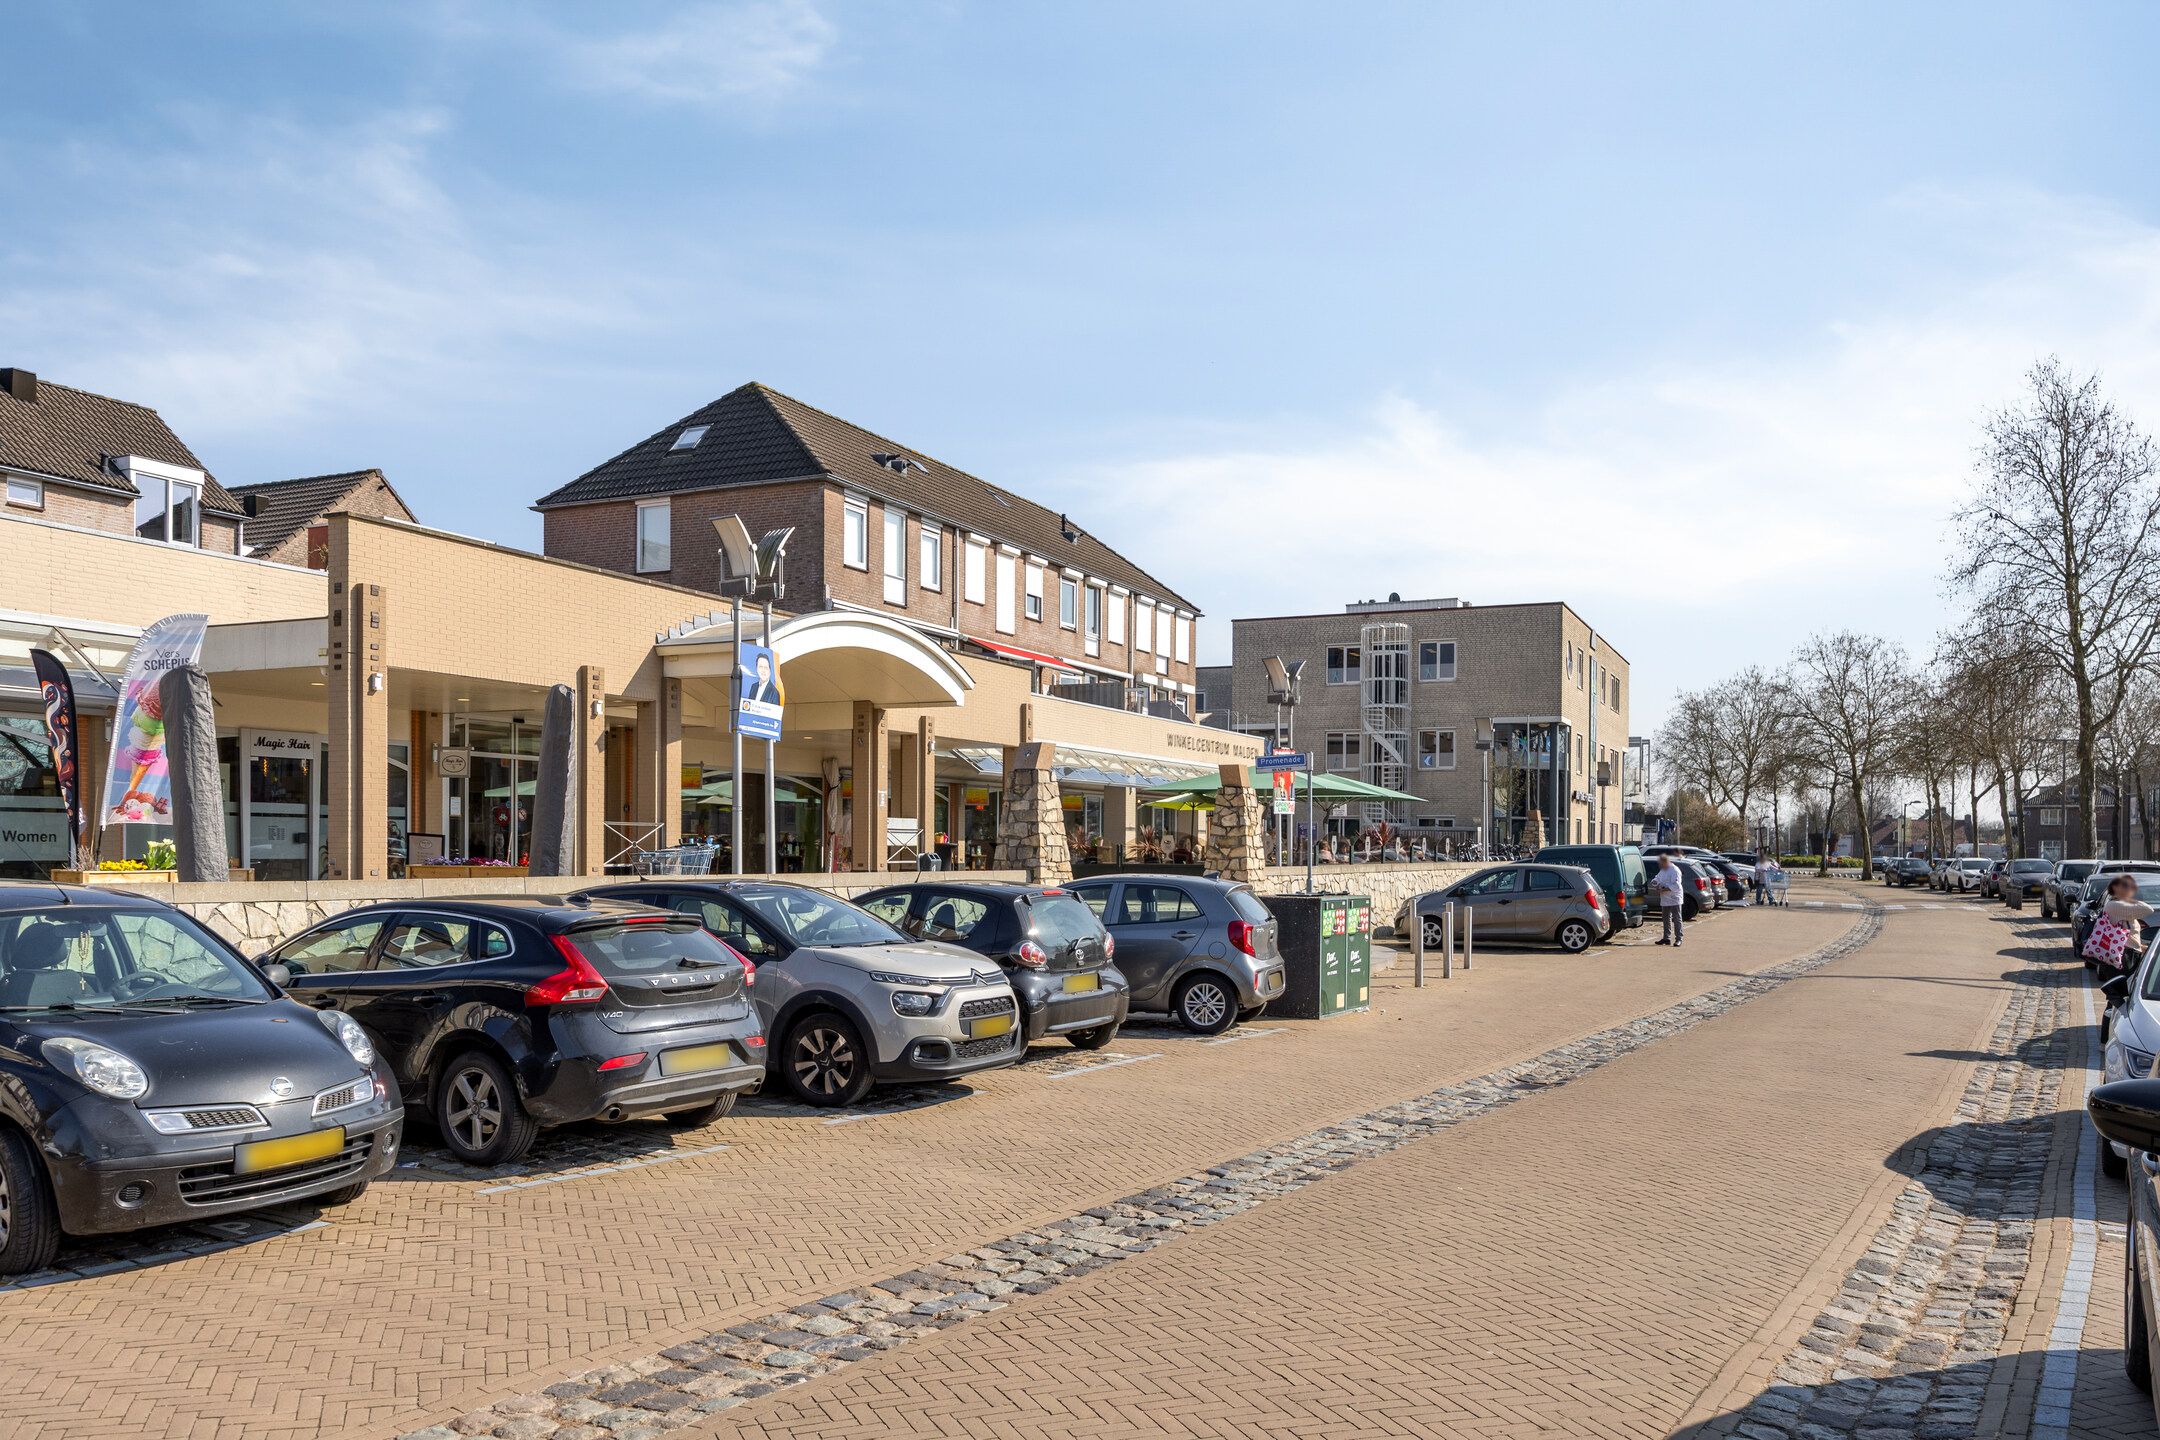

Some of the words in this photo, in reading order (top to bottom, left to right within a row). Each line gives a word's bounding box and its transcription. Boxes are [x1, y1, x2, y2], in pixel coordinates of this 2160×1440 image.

[156, 649, 180, 658] Vers
[254, 736, 286, 750] Magic
[287, 738, 311, 749] Hair
[1167, 733, 1230, 755] WINKELCENTRUM
[1233, 744, 1259, 760] MALDEN
[1260, 756, 1301, 765] Promenade
[2, 830, 57, 843] Women
[651, 973, 725, 986] VOLVO
[602, 1011, 624, 1019] V40
